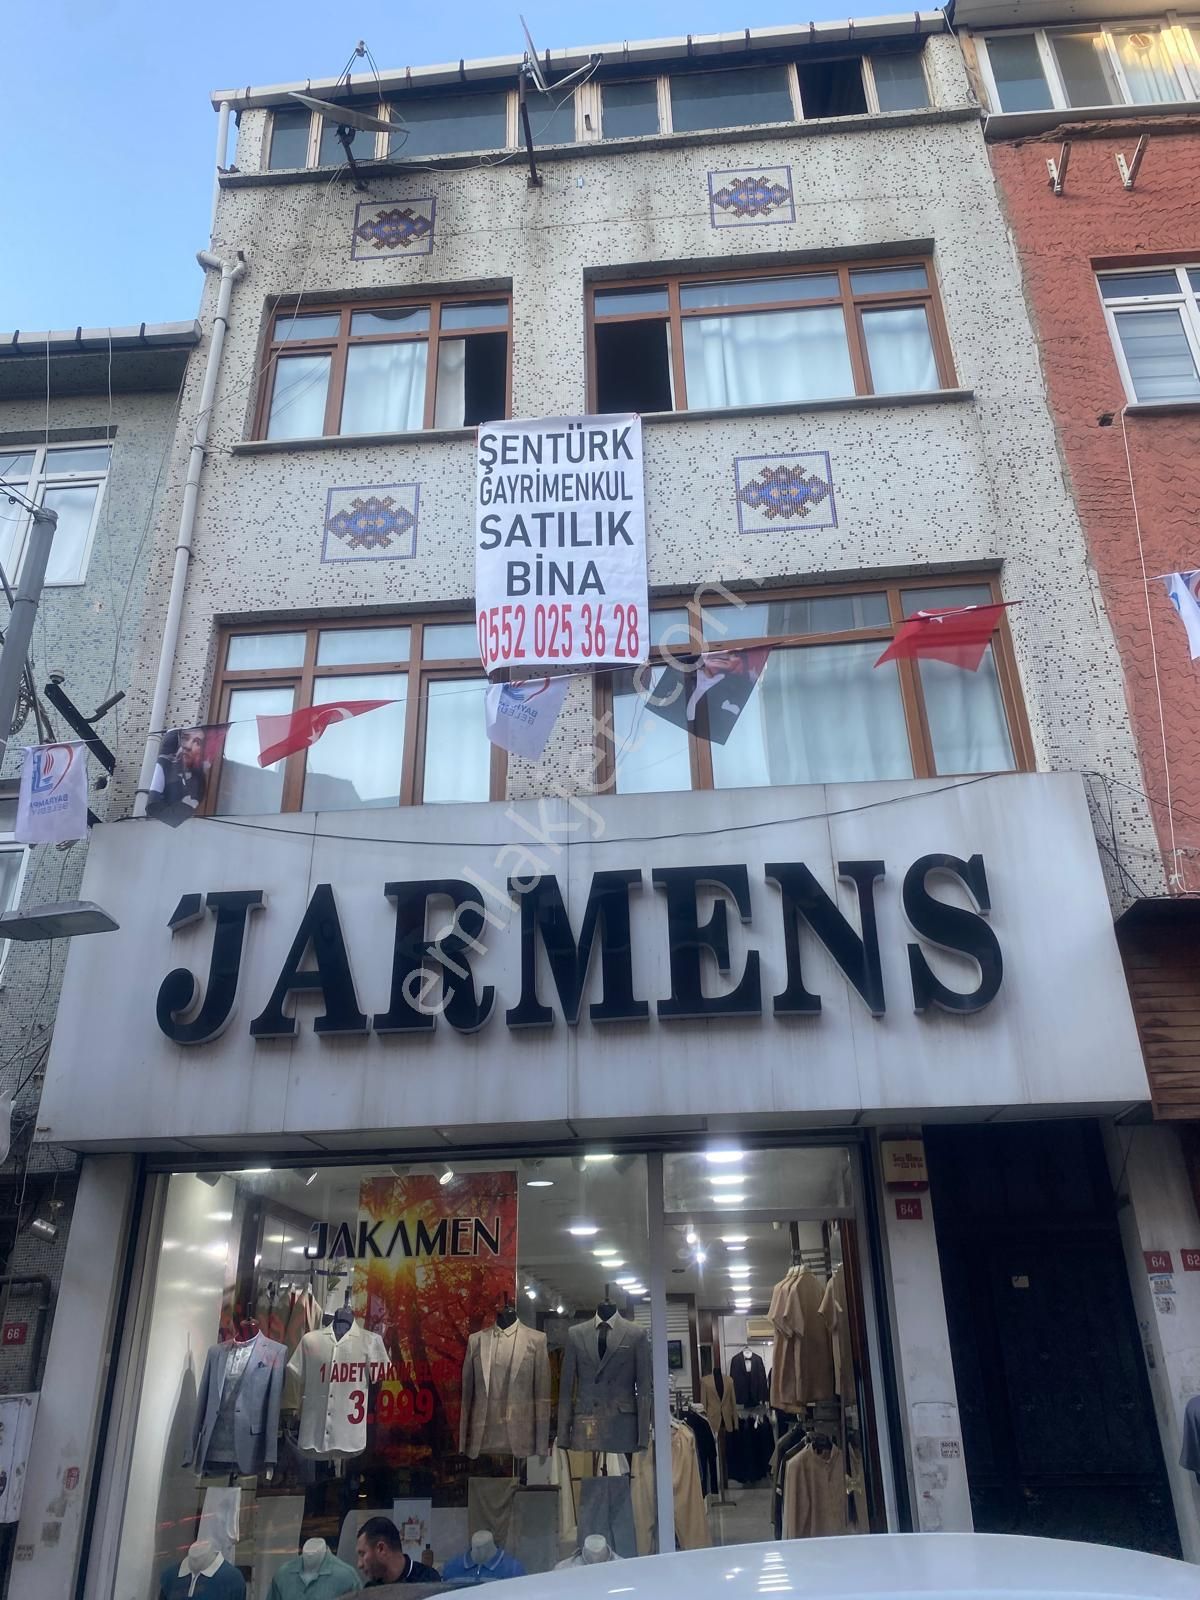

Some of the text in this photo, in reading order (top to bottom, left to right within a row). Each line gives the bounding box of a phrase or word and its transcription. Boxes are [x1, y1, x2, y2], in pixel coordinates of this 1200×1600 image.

[478, 423, 634, 475] ŞENTÜRK
[479, 468, 634, 506] GAYRİMENKUL
[479, 510, 634, 550] SATILIK
[506, 553, 606, 597] BİNA
[478, 603, 639, 668] 0552 025 36 28
[155, 853, 1004, 1046] JARMENS
[305, 1216, 501, 1260] JAKAMEN
[1151, 1256, 1166, 1268] 64
[8, 1328, 19, 1340] 66
[319, 1363, 326, 1383] 1
[330, 1362, 366, 1383] ADET
